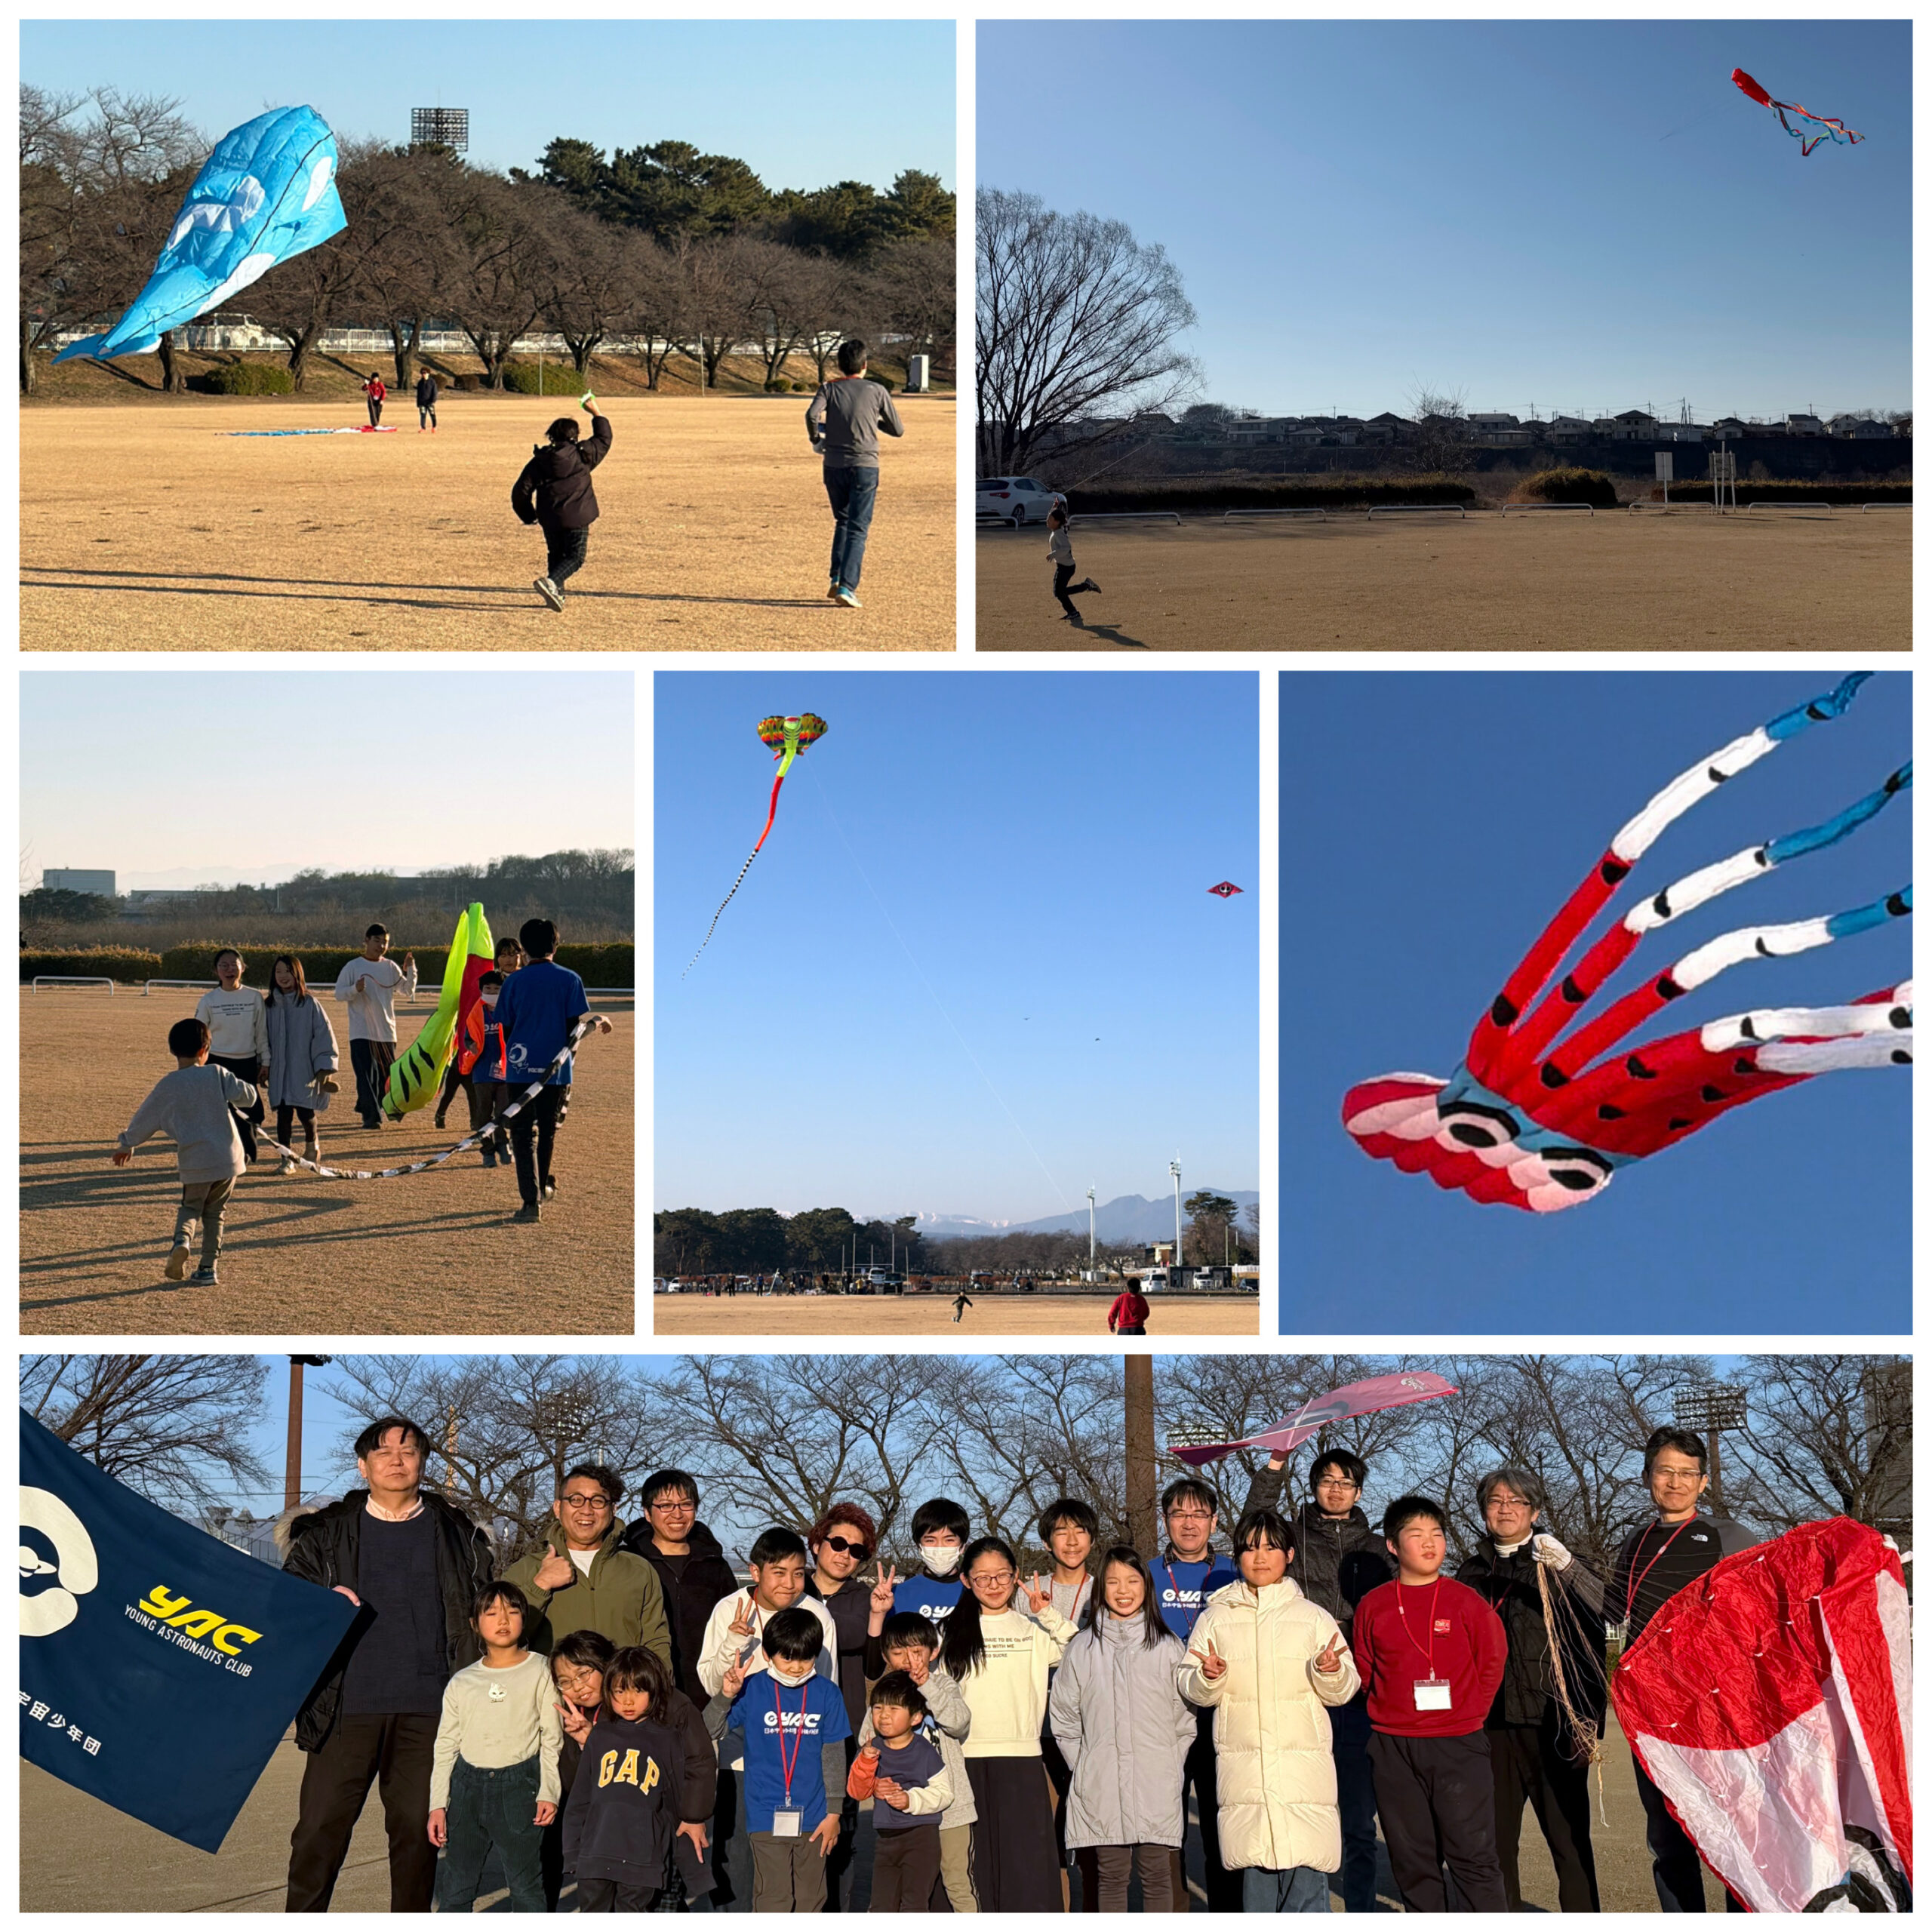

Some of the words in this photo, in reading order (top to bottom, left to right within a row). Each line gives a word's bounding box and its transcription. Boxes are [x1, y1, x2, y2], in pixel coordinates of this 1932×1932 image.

[125, 1604, 157, 1631] YOUNG
[157, 1626, 224, 1665] ASTRONAUTS
[225, 1658, 253, 1677] CLUB
[139, 1585, 264, 1656] YAC
[598, 1748, 660, 1795] GAP
